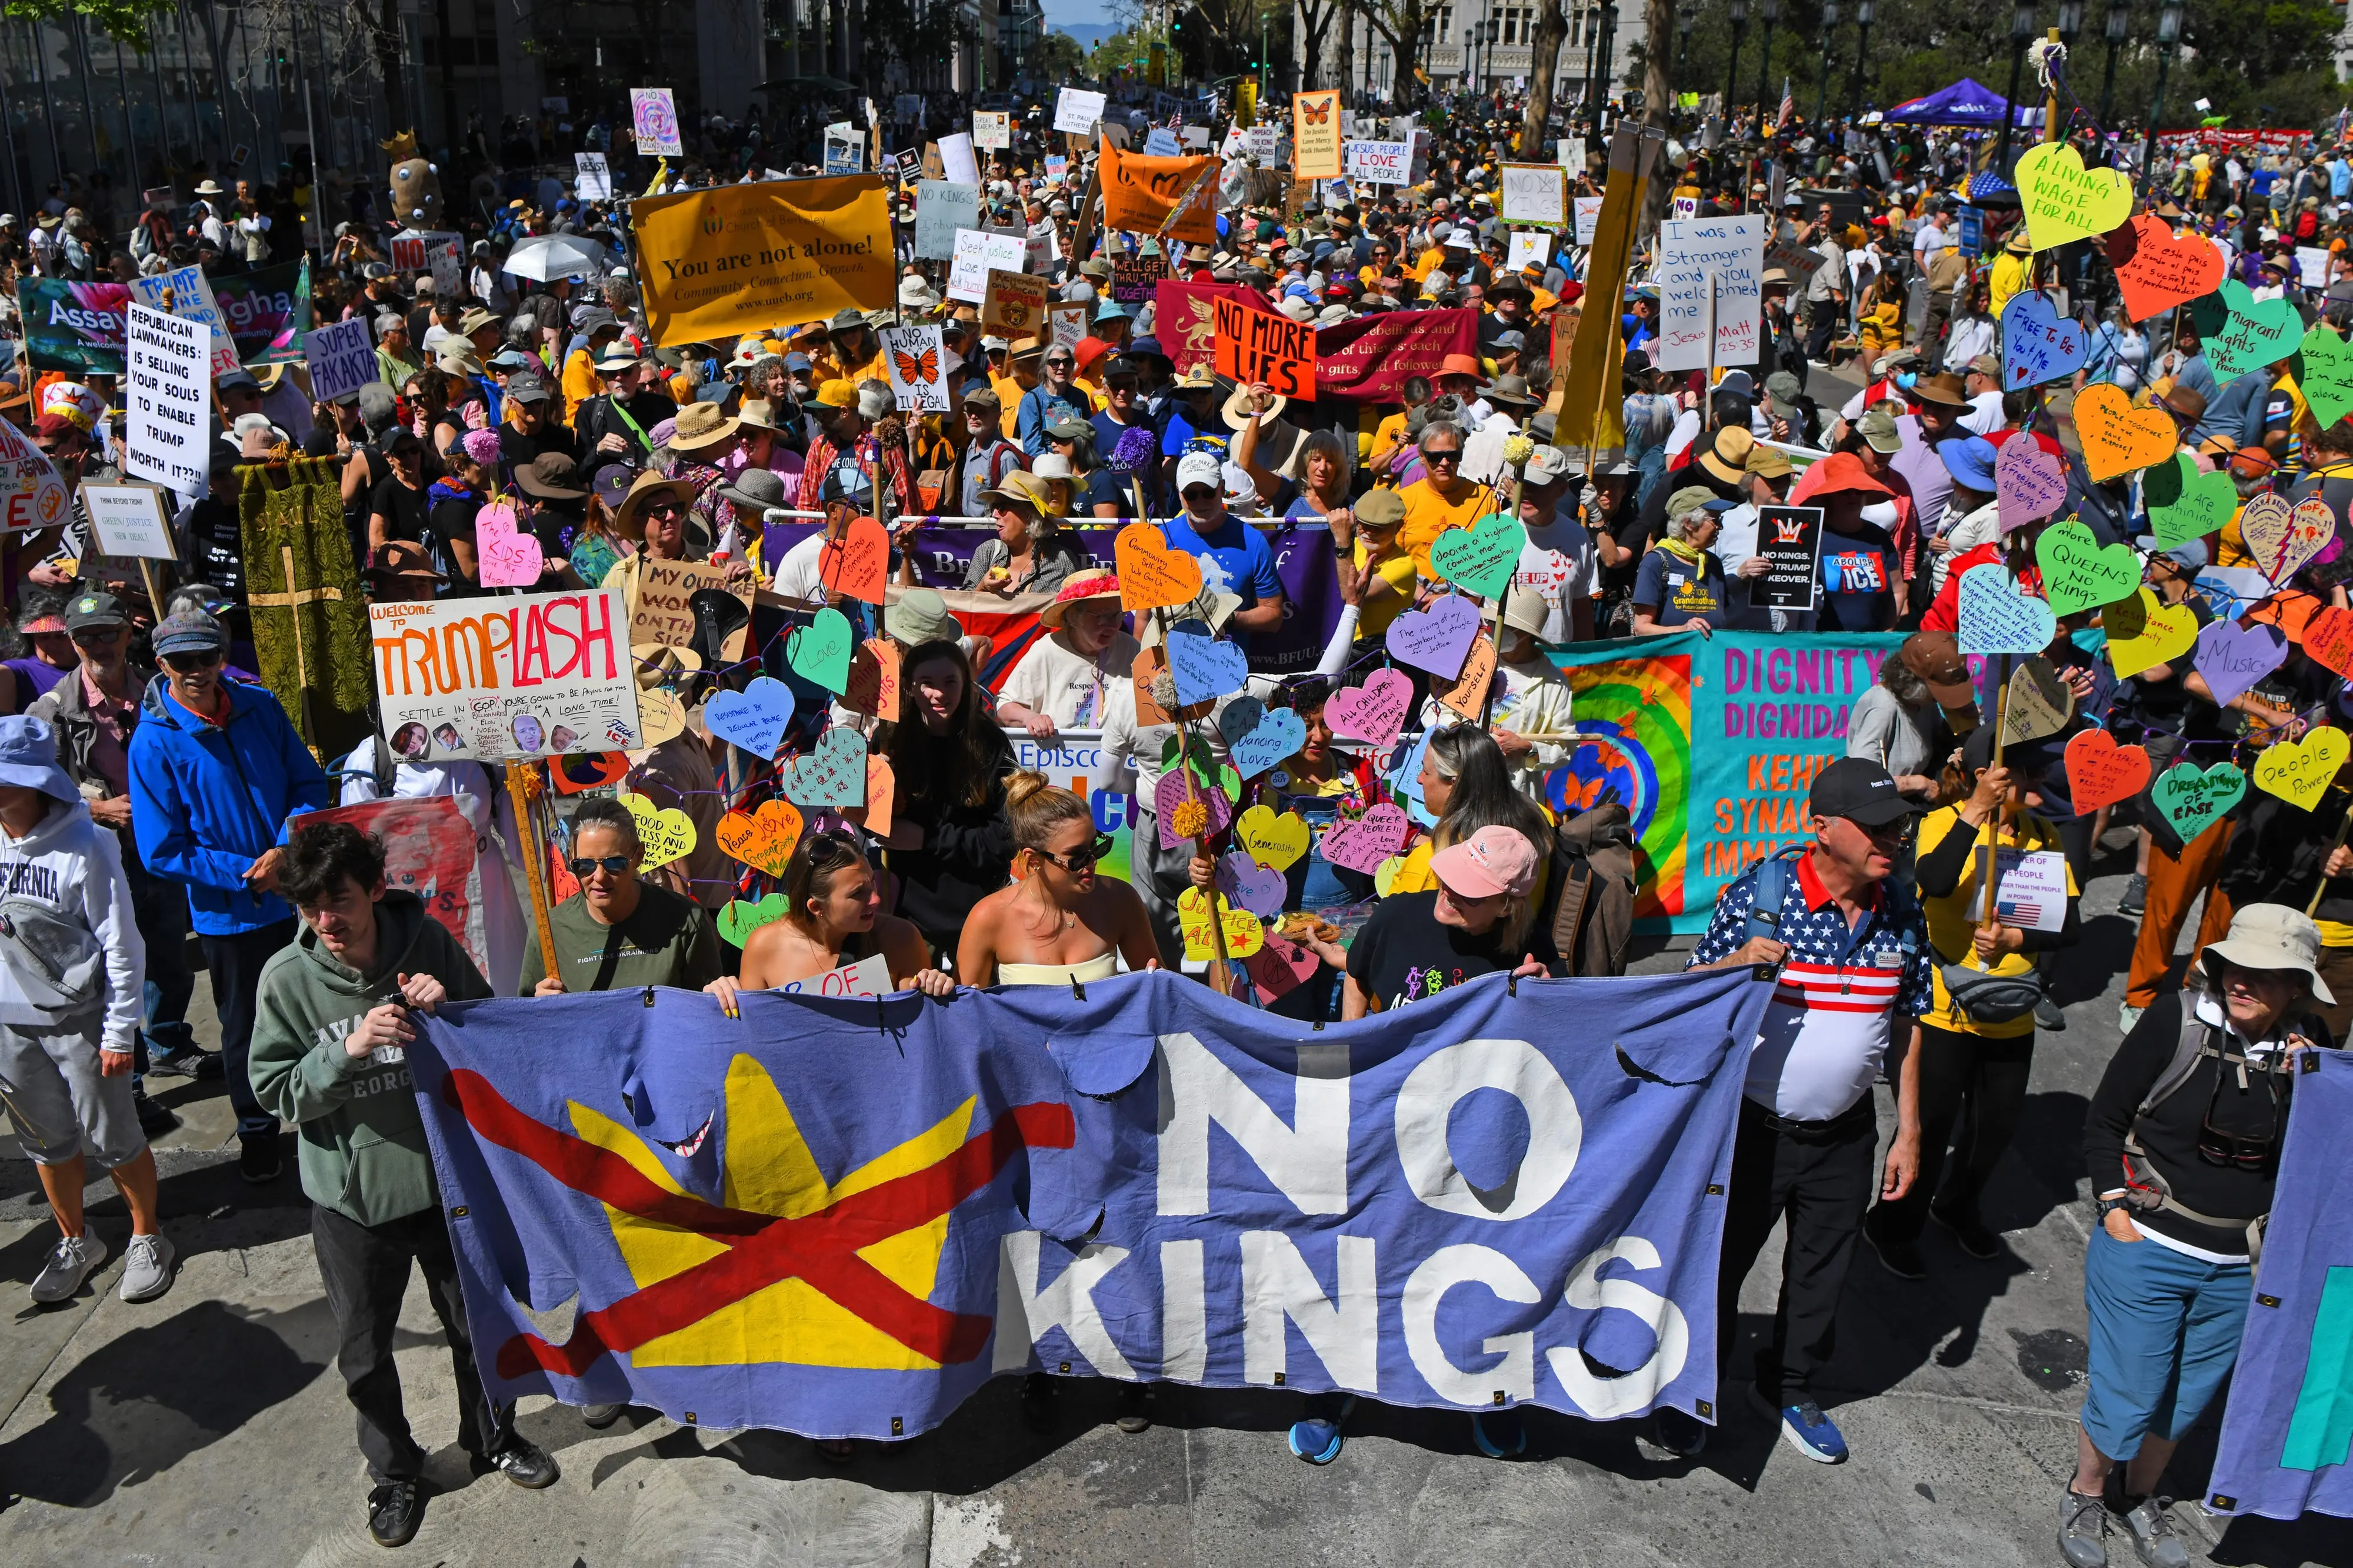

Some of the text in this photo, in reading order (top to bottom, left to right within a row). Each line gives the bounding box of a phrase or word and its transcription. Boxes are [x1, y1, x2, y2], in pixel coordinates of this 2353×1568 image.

[645, 92, 657, 100] NO
[661, 145, 679, 154] KING
[1149, 145, 1176, 155] Compassion
[1154, 138, 1174, 147] Inclusion
[1351, 144, 1407, 155] JESUS PEOPLE
[580, 162, 607, 173] RESIST
[1050, 157, 1060, 165] LET
[1360, 155, 1398, 167] LOVE
[1373, 168, 1402, 179] PEOPLE
[2035, 155, 2111, 200] A LIVING
[1509, 174, 1532, 194] NO
[921, 188, 937, 201] NO
[2033, 177, 2089, 209] WAGE
[1508, 196, 1559, 214] KINGS
[1676, 199, 1694, 212] NO
[2032, 200, 2098, 233] FOR ALL
[726, 221, 762, 234] Church
[1669, 223, 1683, 239] I
[1695, 226, 1726, 239] was
[961, 235, 984, 252] Seek
[393, 239, 425, 269] NO
[662, 235, 872, 280] You are not alone!
[1665, 247, 1752, 265] Stranger
[959, 257, 978, 275] Love
[1115, 261, 1166, 271] WE'LL GET
[139, 270, 198, 299] TRUMP
[1115, 271, 1168, 282] THRU THIS
[1671, 267, 1751, 291] and you
[674, 269, 815, 302] Community. Connection.
[1115, 287, 1156, 299] TOGETHE
[1668, 283, 1758, 301] welcomed
[734, 291, 814, 312] www.uucb.org
[1668, 305, 1698, 318] me
[2202, 294, 2284, 341] Immigrant
[132, 309, 192, 339] REPUBLICAN
[1054, 318, 1079, 337] WRONG
[1217, 301, 1314, 363] NO MORE
[1431, 322, 1455, 335] and
[1718, 321, 1752, 337] Matt
[2011, 305, 2075, 356] FREE BE
[317, 322, 364, 357] SUPER
[902, 328, 922, 339] NO
[131, 327, 201, 359] LAWMAKERS:
[891, 338, 936, 349] HUMAN
[1410, 340, 1441, 352] each
[1717, 337, 1755, 352] 25:35
[2211, 348, 2234, 362] Due
[2303, 349, 2335, 366] seeing
[134, 351, 189, 379] IS SELLING
[311, 348, 380, 398] FAKAKTA
[1235, 348, 1298, 395] LIES
[1328, 363, 1361, 377] gifts,
[2215, 360, 2245, 375] Process
[2305, 366, 2329, 381] I'm
[132, 369, 199, 402] YOUR SOULS
[899, 396, 948, 409] ILLEGAL
[2312, 391, 2345, 403] alone
[158, 404, 195, 426] ENABLE
[146, 425, 184, 448] TRUMP
[130, 447, 165, 472] WORTH
[16, 458, 54, 479] AGAIN
[2299, 503, 2326, 519] HOPE
[102, 518, 153, 527] GREEN/JUSTICE
[131, 533, 148, 542] DEAL!
[488, 539, 525, 563] KIDS
[1435, 543, 1469, 561] daoine
[1761, 551, 1810, 561] NO KINGS.
[1775, 563, 1811, 572] TRUMP
[1832, 556, 1875, 567] ABOLISH
[2053, 544, 2130, 585] QUEENS
[649, 566, 680, 583] MY
[1534, 573, 1547, 583] UP
[1844, 567, 1880, 589] ICE
[2070, 570, 2094, 587] NO
[1125, 575, 1151, 594] HOUSING
[2051, 576, 2098, 607] Kings
[1672, 595, 1717, 606] Grandmothers
[371, 604, 435, 620] WELCOME
[2115, 603, 2174, 633] Resistance
[392, 618, 406, 630] TO
[1398, 629, 1415, 639] The
[1724, 648, 1889, 696] DIGNITY
[1455, 663, 1487, 708] YOURSELF
[1355, 679, 1394, 711] CHILDREN
[399, 693, 555, 721] SETTLE GOING
[559, 697, 619, 716] LONG TIME!
[715, 708, 749, 722] RESISTANCE
[1378, 701, 1402, 726] TRANS
[726, 720, 759, 734] REGULAR
[1237, 734, 1281, 752] Dancing
[1240, 752, 1272, 768] LOVE
[2262, 746, 2331, 783] People
[2291, 772, 2332, 798] Power
[2184, 790, 2204, 805] OF
[1367, 813, 1401, 825] QUEER
[2174, 802, 2214, 822] EASE
[1361, 823, 1402, 836] PEOPLE!!!
[663, 835, 686, 851] AND
[718, 829, 753, 853] Peace
[1248, 830, 1295, 859] Generosity
[2014, 870, 2044, 879] PEOPLE
[737, 913, 776, 936] Unity
[616, 947, 659, 958] UKRAINIANS
[822, 965, 859, 995] OF
[1157, 1033, 1582, 1223] NO
[991, 1228, 1688, 1421] KINGS
